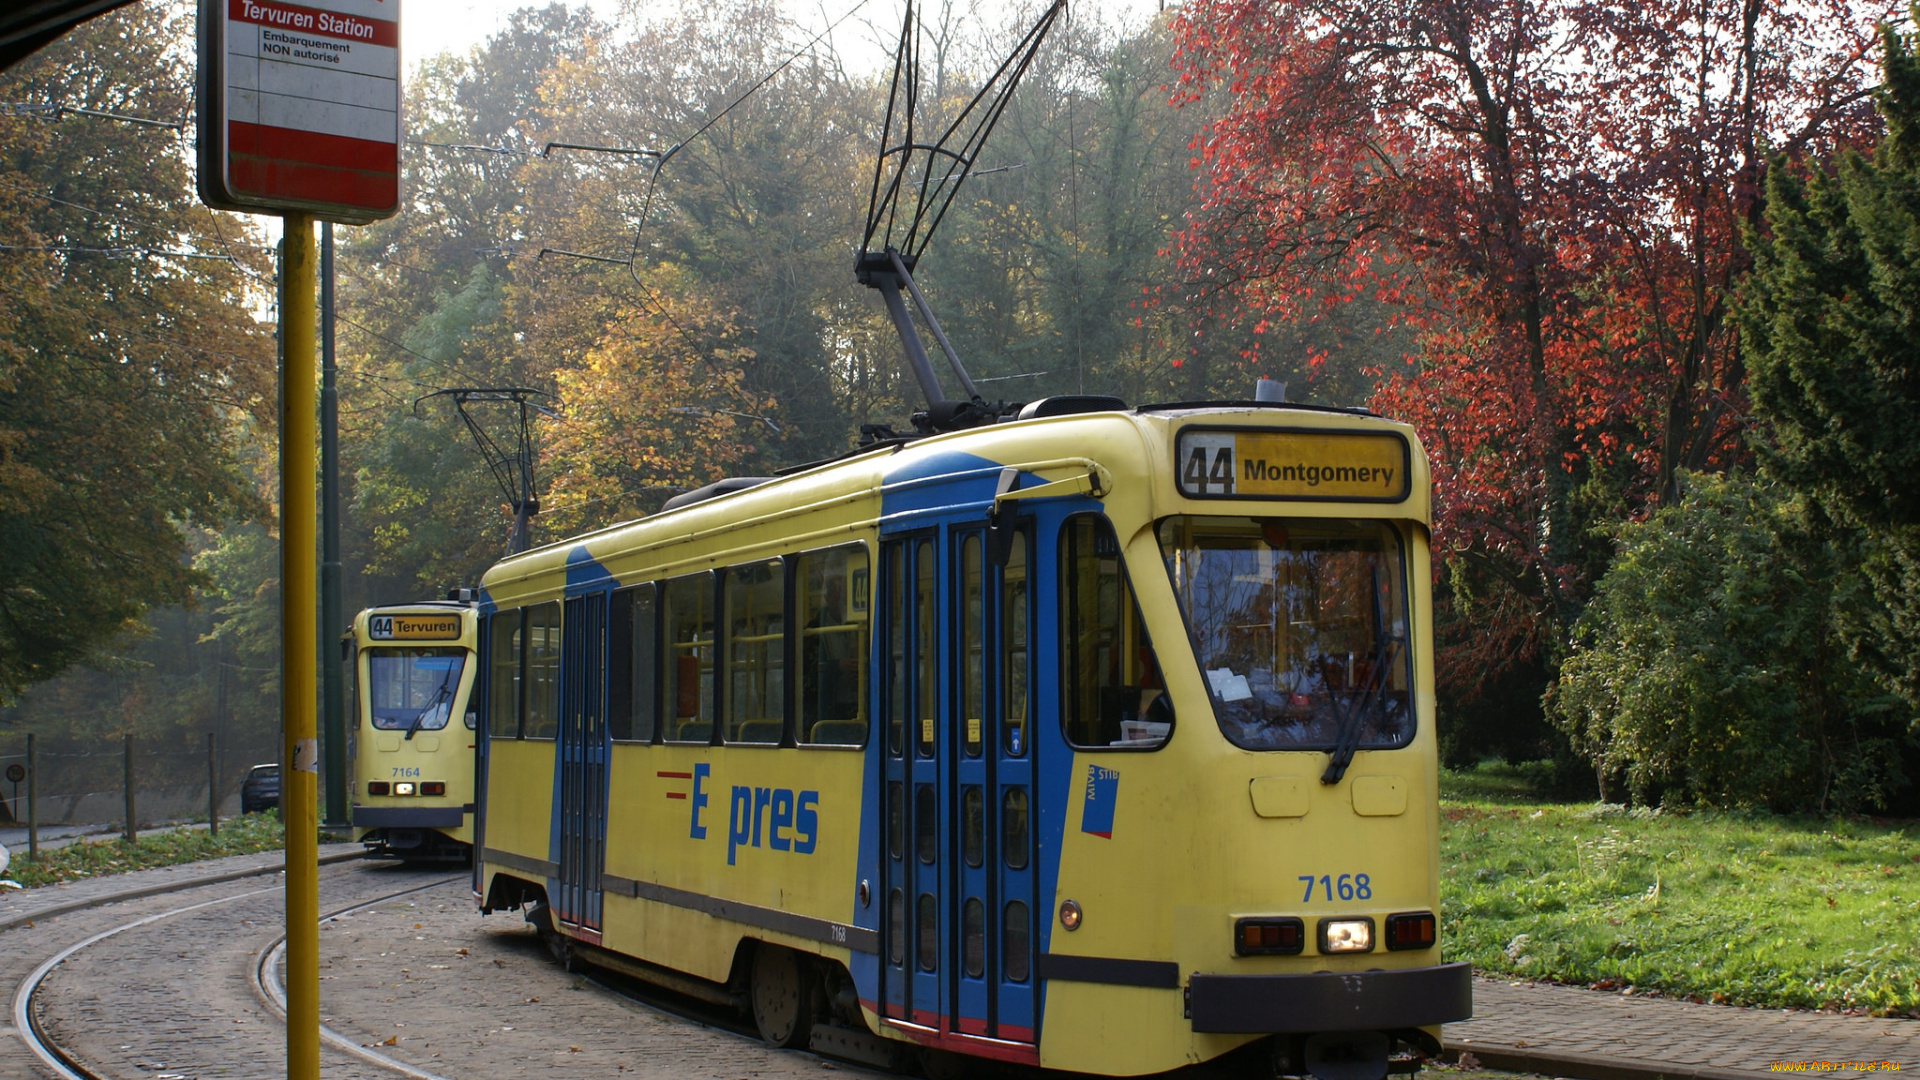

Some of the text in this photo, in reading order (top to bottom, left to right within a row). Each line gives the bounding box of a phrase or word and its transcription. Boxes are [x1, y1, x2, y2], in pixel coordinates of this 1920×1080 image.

[242, 0, 374, 39] Tervuren Station
[263, 30, 351, 53] Embarquement
[263, 43, 340, 64] NON autorisé
[1184, 446, 1394, 494] 44 Montgomery
[374, 618, 456, 636] 44 Tervuren
[392, 767, 420, 778] 7164
[1087, 766, 1096, 800] MIVB
[1098, 769, 1119, 780] STIB
[1298, 873, 1373, 903] 7168
[831, 925, 846, 942] 7168
